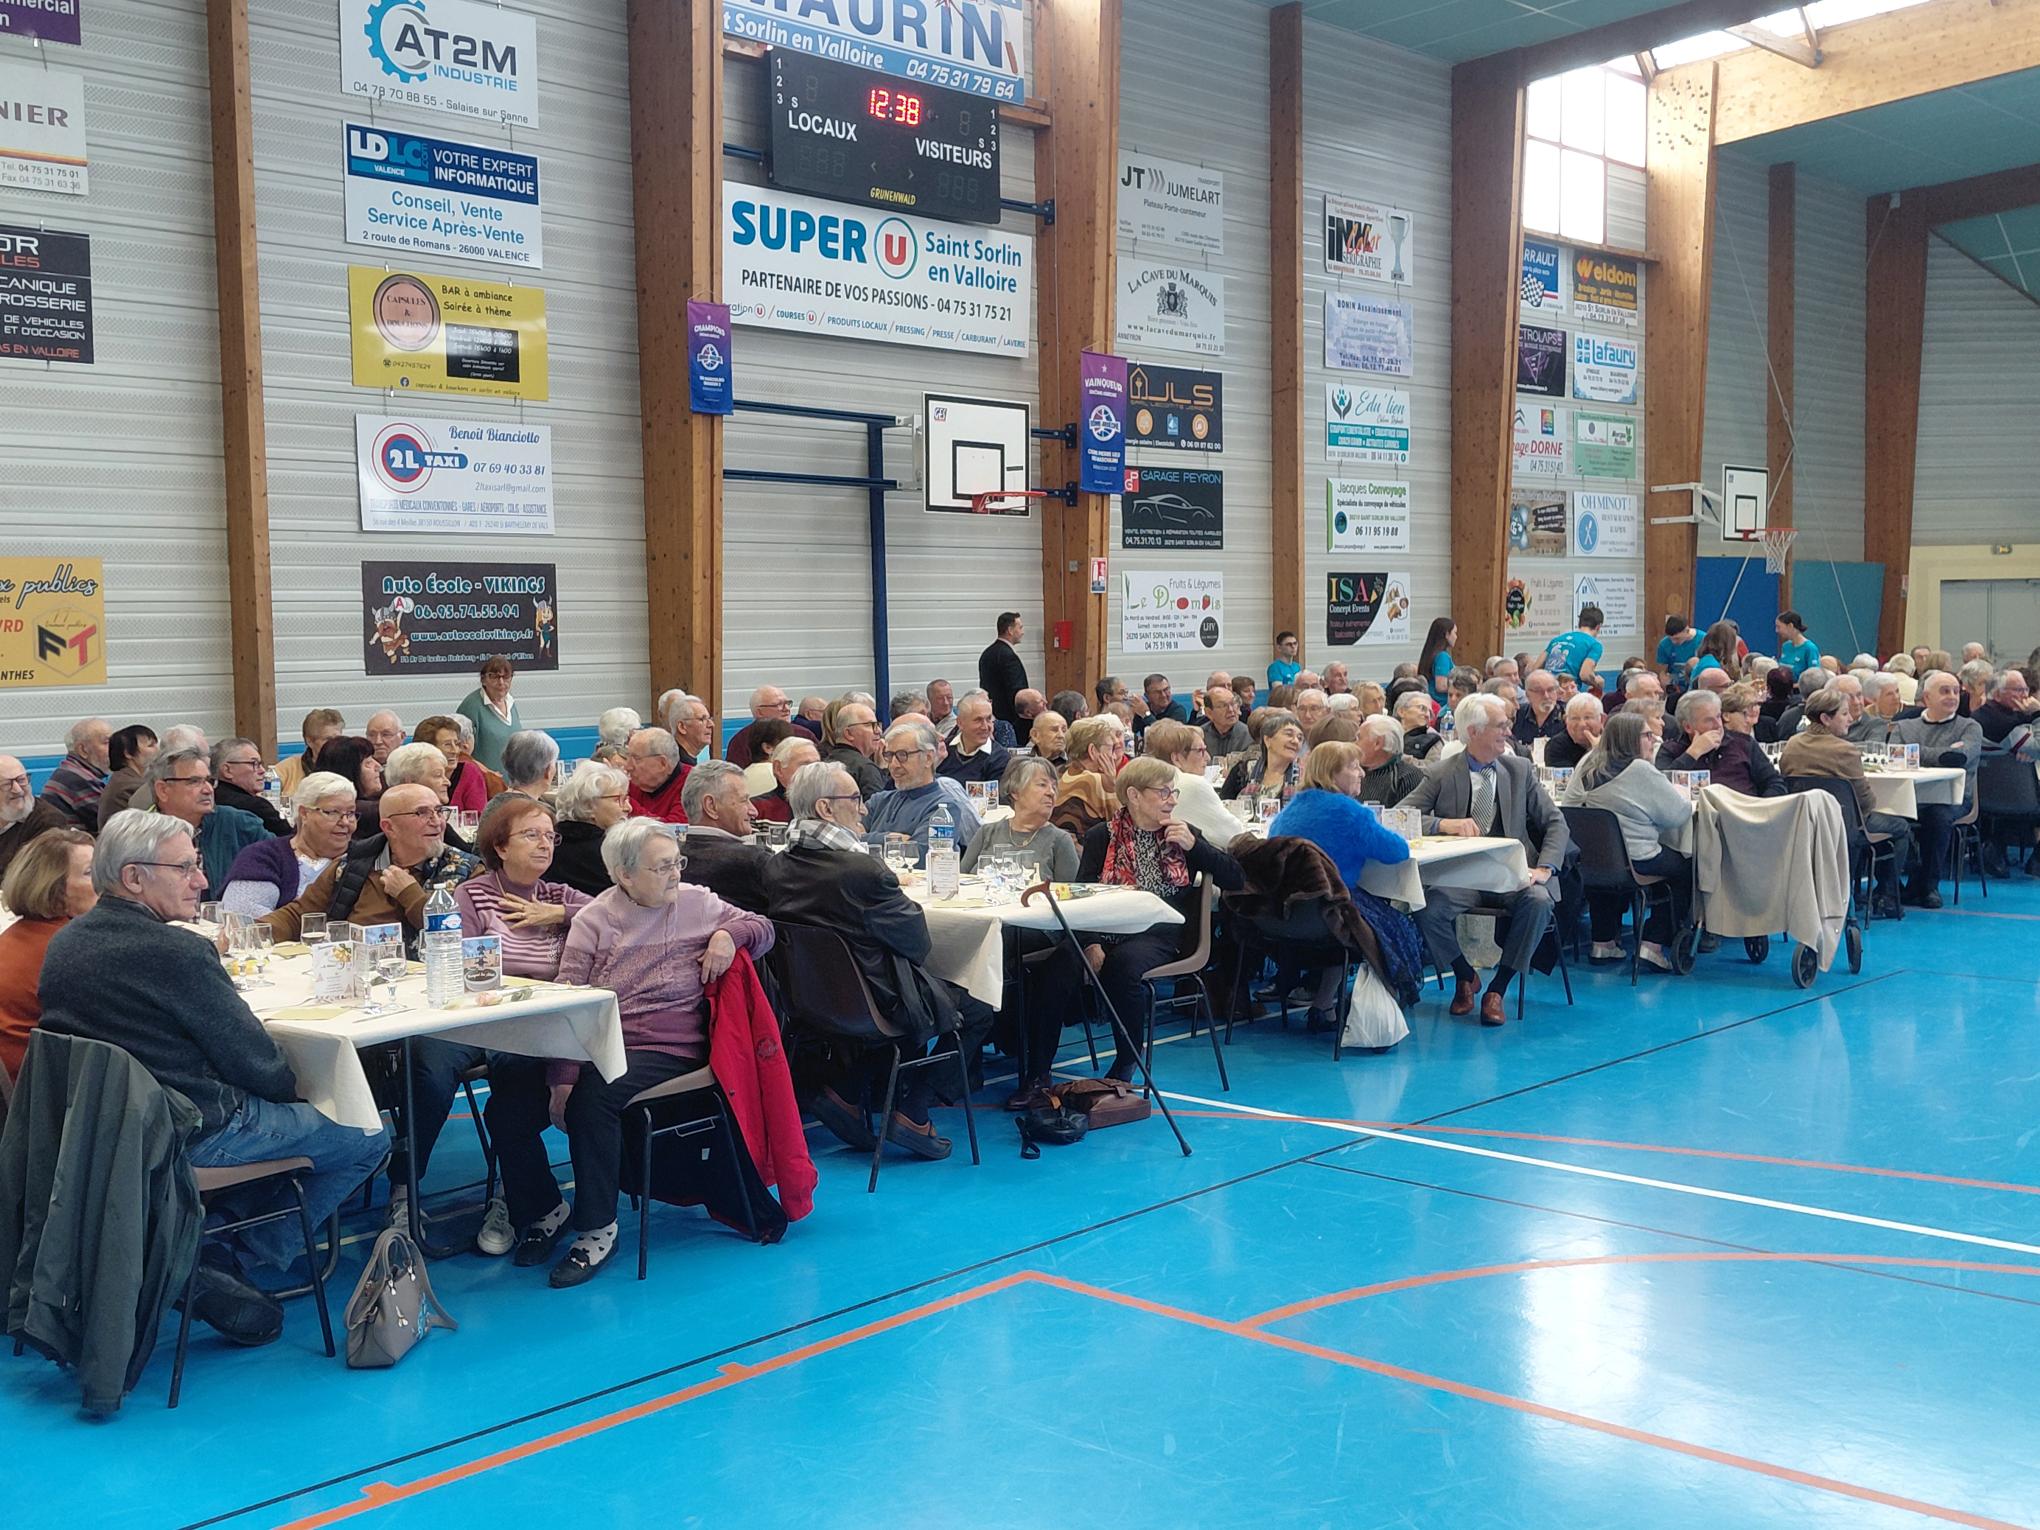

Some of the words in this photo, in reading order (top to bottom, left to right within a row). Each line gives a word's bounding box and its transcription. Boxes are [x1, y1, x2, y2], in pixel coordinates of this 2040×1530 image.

[394, 23, 517, 76] AT2M
[734, 13, 787, 45] Sorlin
[792, 33, 813, 51] en
[817, 34, 885, 69] Valloire
[906, 58, 927, 79] 04
[930, 64, 949, 83] 75
[949, 70, 969, 89] 31
[972, 75, 992, 93] 79
[995, 79, 1015, 99] 64
[776, 58, 782, 69] 1
[434, 63, 518, 91] INDUSTRIE
[776, 75, 783, 87] 2
[353, 81, 368, 92] 04
[390, 88, 403, 99] 70
[423, 95, 437, 106] 55
[446, 99, 479, 114] Salaise
[482, 107, 498, 118] sur
[500, 109, 529, 124] Sanne
[776, 93, 784, 104] 3
[791, 96, 799, 108] S
[870, 89, 920, 125] 12:38
[990, 109, 996, 119] 1
[788, 110, 858, 142] LOCAUX
[990, 124, 997, 135] 2
[350, 129, 422, 168] LDLC
[915, 137, 992, 170] VISITEURS
[979, 138, 985, 149] S
[990, 140, 997, 151] 3
[374, 164, 406, 177] VALENCE
[433, 148, 479, 169] VOTRE
[482, 157, 534, 178] EXPERT
[435, 166, 535, 196] INFORMATIQUE
[1121, 166, 1145, 189] JT
[870, 187, 917, 206] GRUNENWALD
[1167, 182, 1220, 206] JUMELART
[392, 190, 456, 217] Conseil,
[461, 201, 503, 221] Vente
[367, 207, 428, 231] Service
[432, 218, 525, 245] Après-Vente
[731, 200, 867, 264] SUPER
[884, 233, 907, 266] U
[362, 230, 369, 240] 2
[371, 233, 397, 244] route
[399, 236, 410, 246] de
[413, 239, 450, 251] Romans
[459, 244, 485, 256] 26000
[487, 248, 530, 262] VALENCE
[925, 231, 971, 258] Saint
[974, 239, 1022, 267] Sorlin
[928, 264, 950, 283] en
[954, 264, 1017, 294] Valloire
[1166, 269, 1178, 280] DU
[1576, 257, 1636, 287] Weldom
[442, 284, 460, 297] BAR
[465, 287, 470, 297] à
[473, 289, 513, 302] ambiance
[742, 269, 822, 296] PARTENAIRE
[825, 282, 842, 299] DE
[844, 284, 869, 302] VOS
[871, 288, 929, 310] PASSIONS
[937, 297, 951, 313] 04
[954, 300, 966, 316] 75
[969, 302, 981, 318] 31
[984, 304, 998, 319] 75
[999, 306, 1011, 321] 21
[4, 314, 20, 323] DE
[443, 301, 472, 314] Soirée
[477, 303, 482, 314] à
[485, 304, 512, 317] thème
[4, 325, 18, 334] ET
[22, 327, 85, 340] D'OCCASION
[776, 310, 805, 321] COURSES
[828, 316, 860, 328] PRODUITS
[862, 319, 887, 332] LOCAUX
[895, 325, 925, 336] PRESSING
[932, 329, 954, 340] PRESSE
[961, 333, 997, 344] CARBURANT
[13, 344, 28, 354] EN
[32, 346, 80, 358] VALLOIRE
[390, 448, 420, 469] 2L
[424, 455, 460, 468] TAXI
[1531, 440, 1562, 456] DORNE
[474, 463, 486, 473] 07
[489, 463, 501, 473] 69
[504, 463, 517, 474] 40
[519, 465, 532, 475] 33
[534, 465, 546, 475] 81
[1141, 470, 1180, 482] GARAGE
[1184, 472, 1221, 484] PEYRON
[1337, 482, 1367, 496] Jacques
[16, 564, 98, 609] publics
[382, 576, 423, 594] Auto
[426, 572, 472, 594] École
[483, 576, 546, 595] VIKINGS
[1169, 577, 1186, 589] Fruits
[1329, 576, 1370, 602] ISA
[413, 604, 520, 620] 06.95.74.55.94
[1329, 604, 1351, 615] Concept
[1352, 604, 1370, 613] Events
